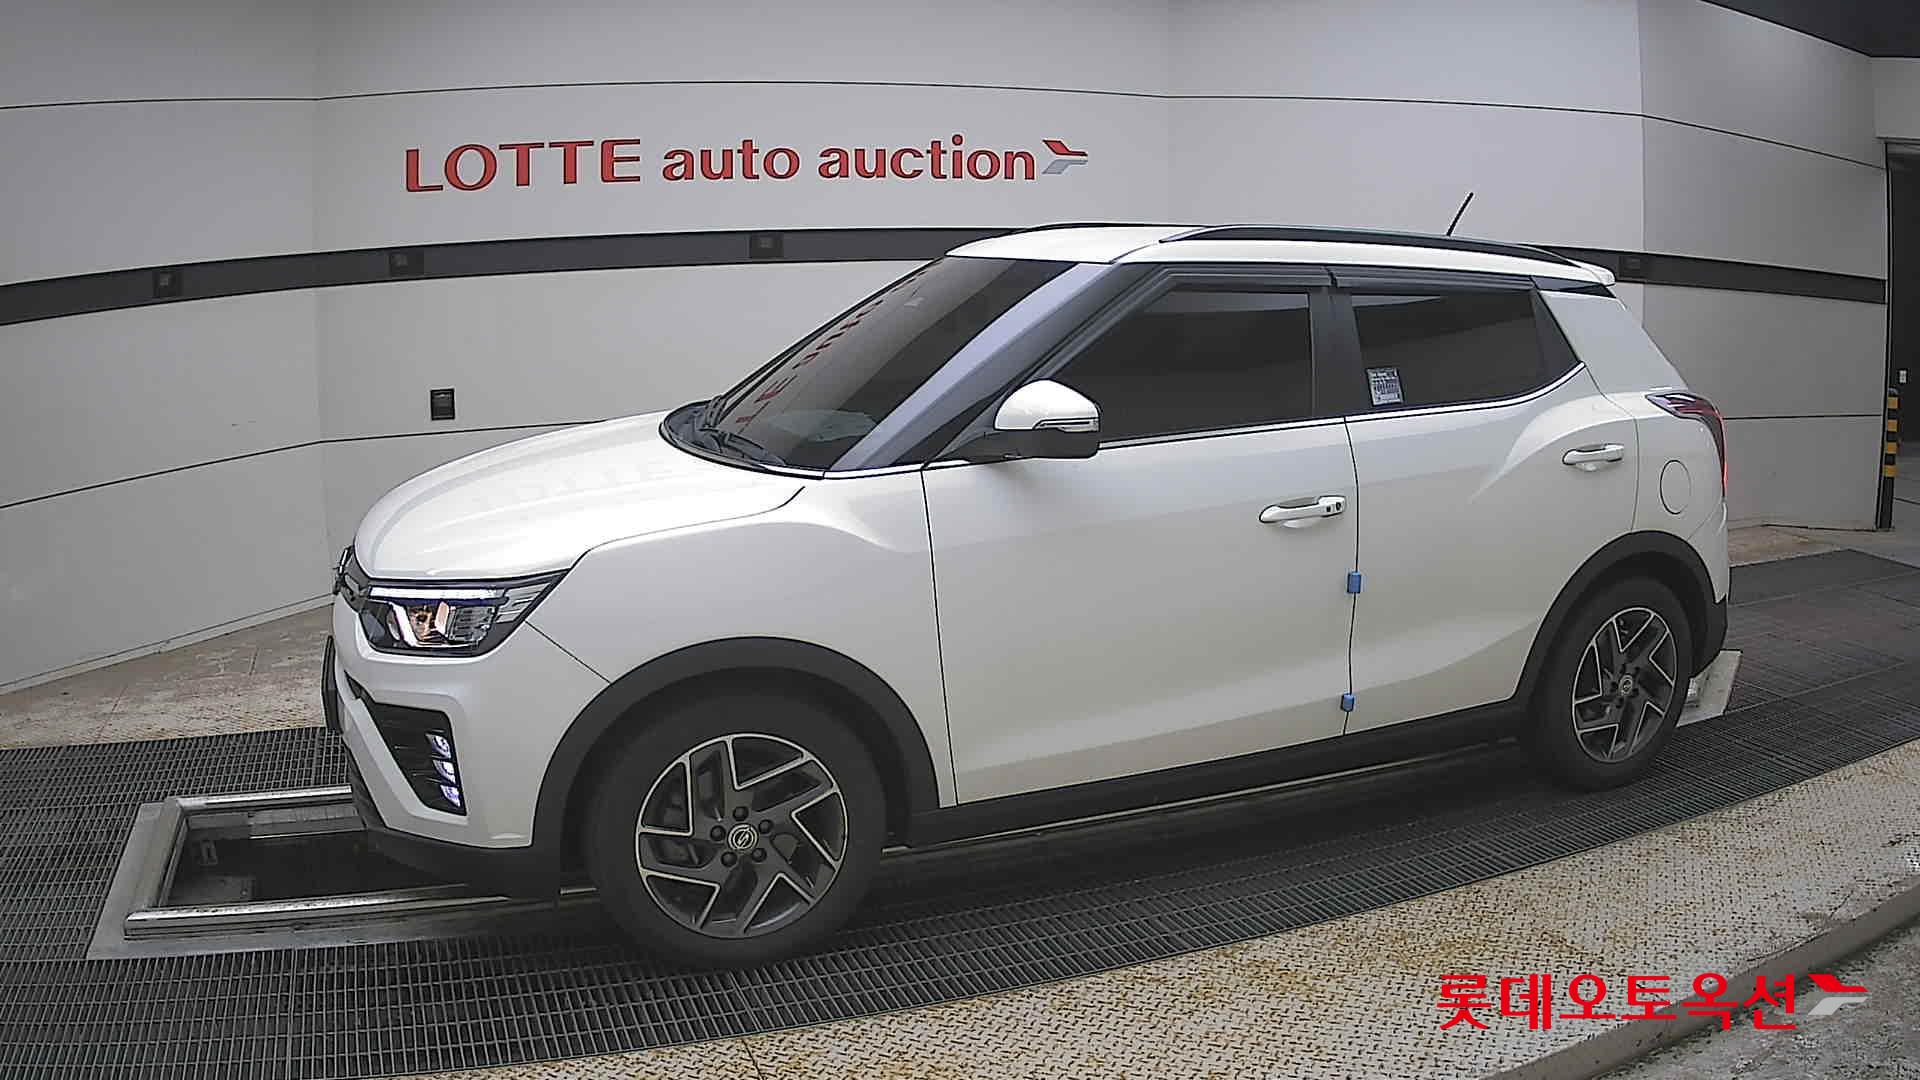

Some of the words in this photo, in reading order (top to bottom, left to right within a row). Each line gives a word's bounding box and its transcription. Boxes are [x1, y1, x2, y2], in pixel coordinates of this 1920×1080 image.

[405, 138, 641, 192] LOTTE
[663, 138, 800, 181] auto
[818, 134, 1036, 180] auction
